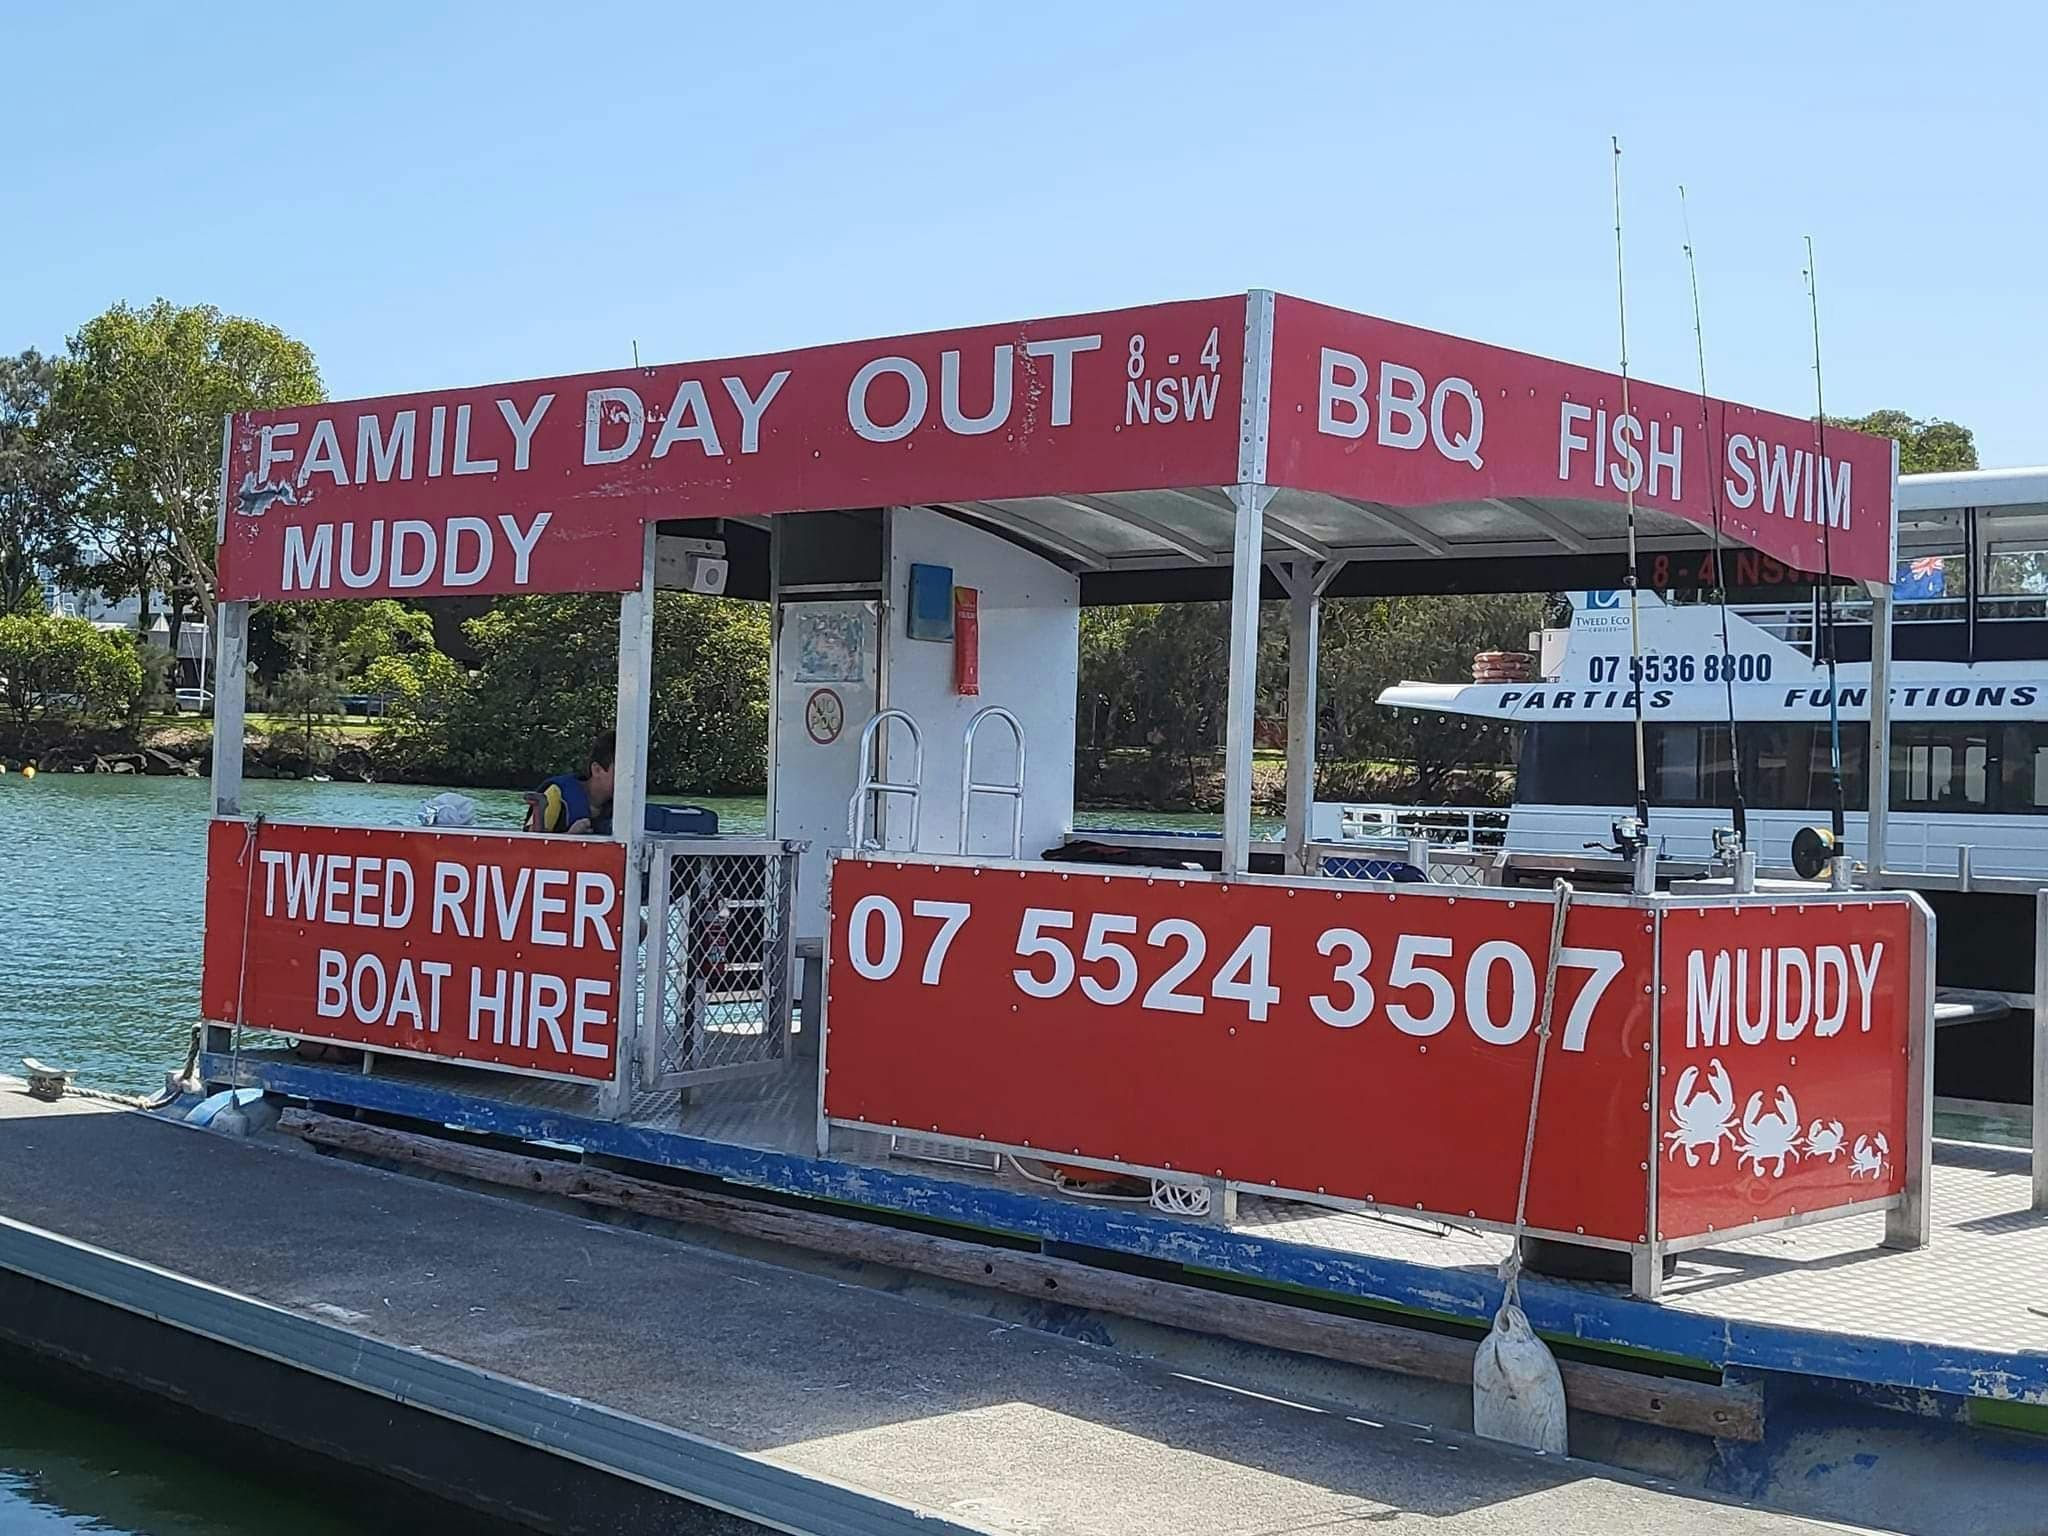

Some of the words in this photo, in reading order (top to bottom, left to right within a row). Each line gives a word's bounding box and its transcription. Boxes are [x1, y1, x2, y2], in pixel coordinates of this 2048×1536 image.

[1127, 333, 1146, 379] 8
[1200, 326, 1220, 373] 4
[257, 393, 556, 487] FAMILY
[583, 371, 791, 465] DAY
[847, 334, 1101, 443] OUT
[1125, 374, 1220, 425] NSW
[1317, 346, 1485, 470] BBQ
[1559, 401, 1684, 500] FISH
[1724, 434, 1853, 531] SWIM
[281, 512, 553, 592] MUDDY
[1653, 555, 1670, 588] 8
[1736, 550, 1817, 586] NS
[1498, 690, 1674, 709] PARTIES
[1589, 656, 1620, 683] 07
[1629, 655, 1695, 683] 5536
[1703, 654, 1772, 682] 8800
[259, 849, 415, 929] TWEED
[431, 861, 616, 951] RIVER
[316, 948, 452, 1033] BOAT
[468, 966, 611, 1059] HIRE
[847, 894, 972, 987] 07
[1013, 908, 1281, 1022] 5524
[1308, 928, 1625, 1053] 3507
[1685, 942, 1884, 1048] MUDDY
